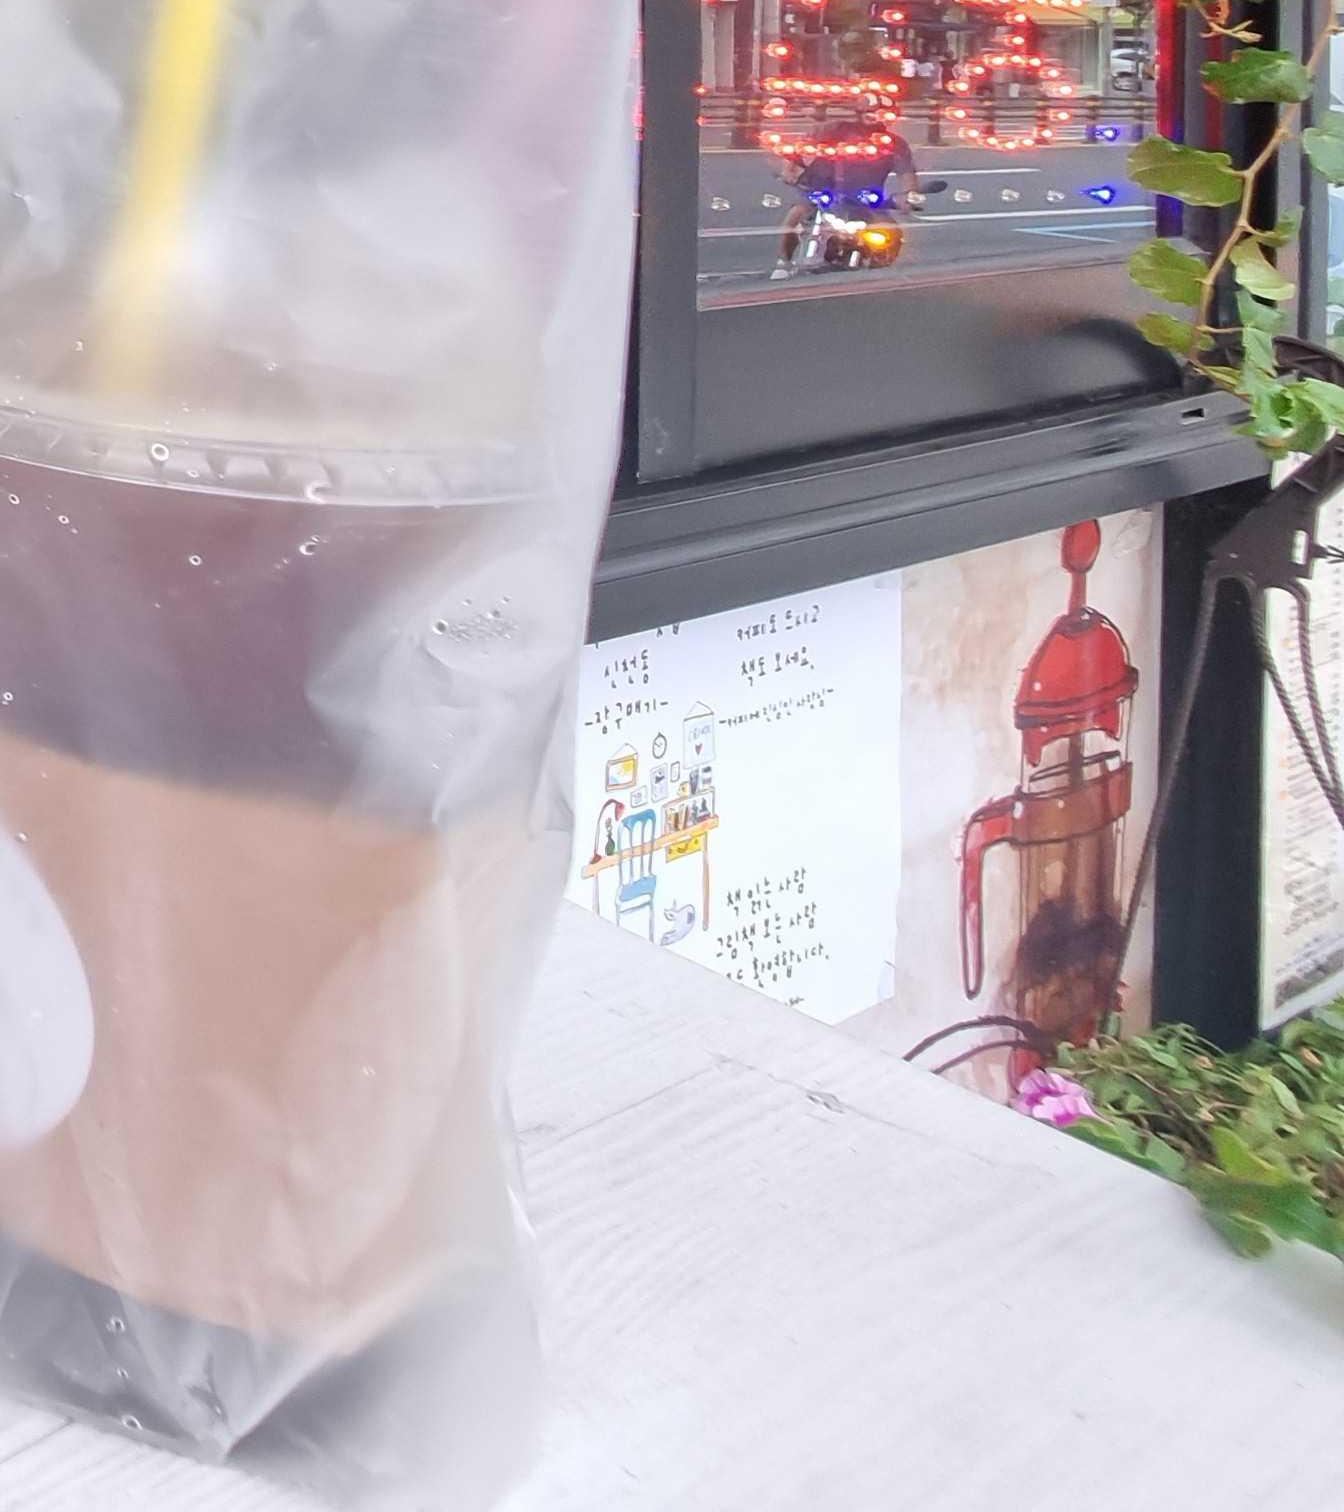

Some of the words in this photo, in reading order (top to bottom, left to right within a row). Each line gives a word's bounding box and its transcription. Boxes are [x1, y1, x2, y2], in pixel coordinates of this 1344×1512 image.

[726, 888, 741, 917] 책
[778, 867, 806, 894] 사람
[789, 901, 816, 929] 사람
